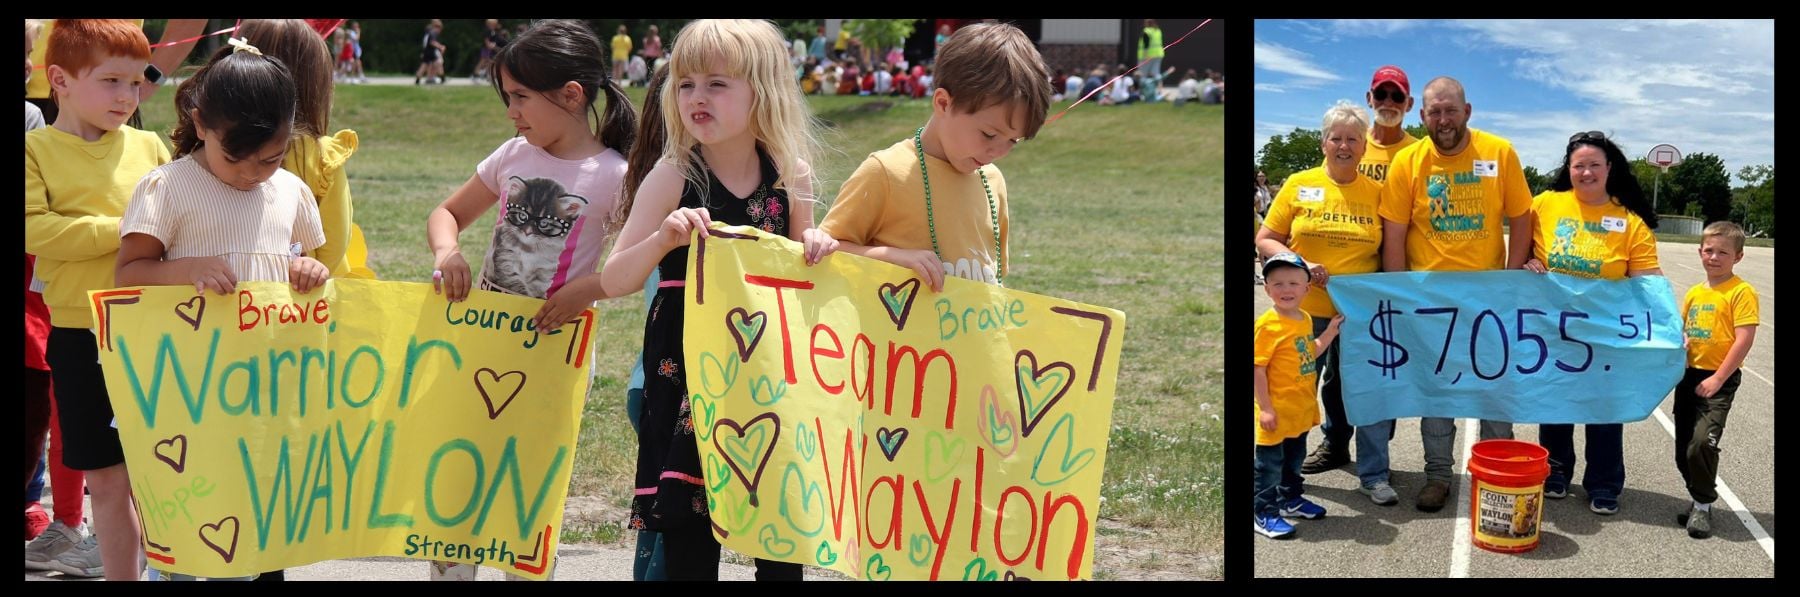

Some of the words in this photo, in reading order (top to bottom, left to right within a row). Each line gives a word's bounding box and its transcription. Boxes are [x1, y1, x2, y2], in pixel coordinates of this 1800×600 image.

[1358, 163, 1388, 181] HASI
[1447, 200, 1484, 216] CANCER
[237, 289, 329, 331] Brave
[446, 301, 562, 349] Courag
[934, 298, 1029, 340] Brave
[1618, 311, 1652, 342] 51
[744, 273, 959, 430] Team
[116, 320, 463, 430] Warrior
[137, 474, 217, 538] Hope
[237, 419, 568, 552] WAYLON
[815, 416, 1090, 581] Waylon
[1485, 492, 1508, 503] COIN
[1481, 508, 1514, 522] WAYLON
[404, 533, 516, 566] Strength
